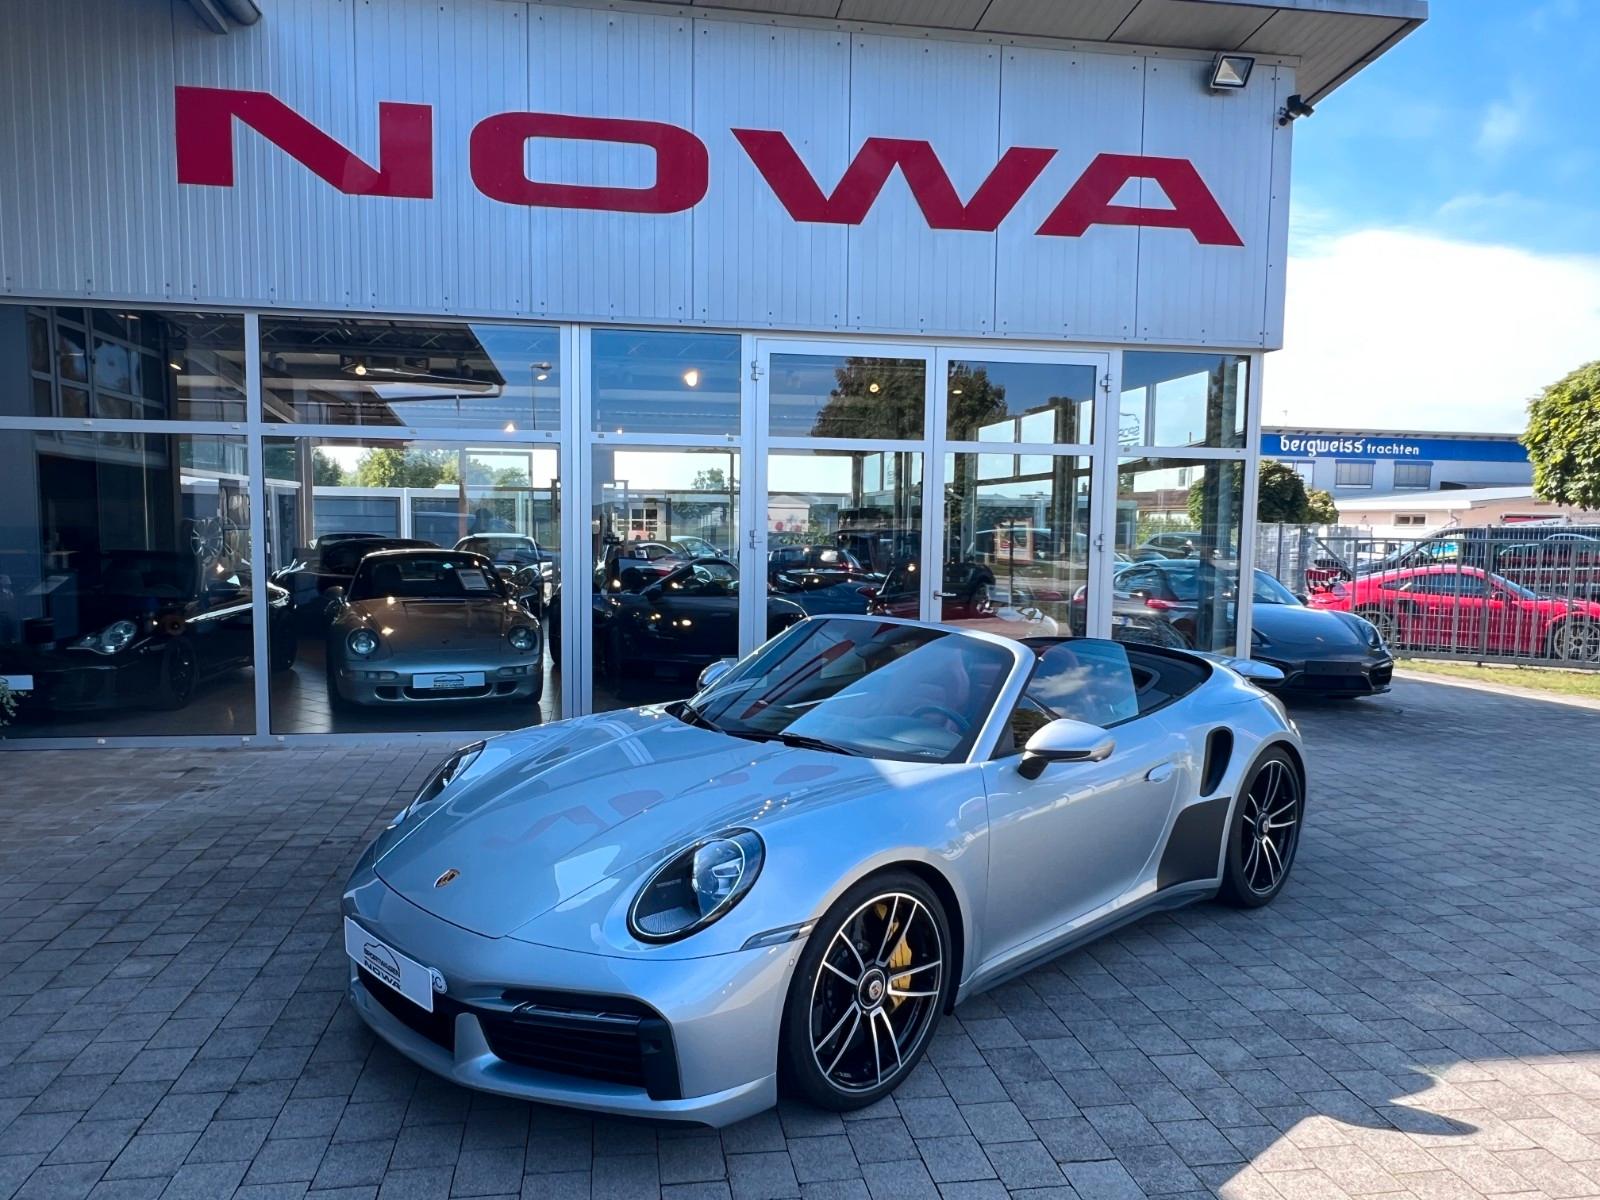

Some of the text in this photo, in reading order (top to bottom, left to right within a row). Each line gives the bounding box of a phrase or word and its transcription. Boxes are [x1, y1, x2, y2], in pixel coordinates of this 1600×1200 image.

[175, 86, 1245, 247] NOWA
[1280, 435, 1420, 457] bergweiss trachten
[364, 960, 402, 990] NOWA
